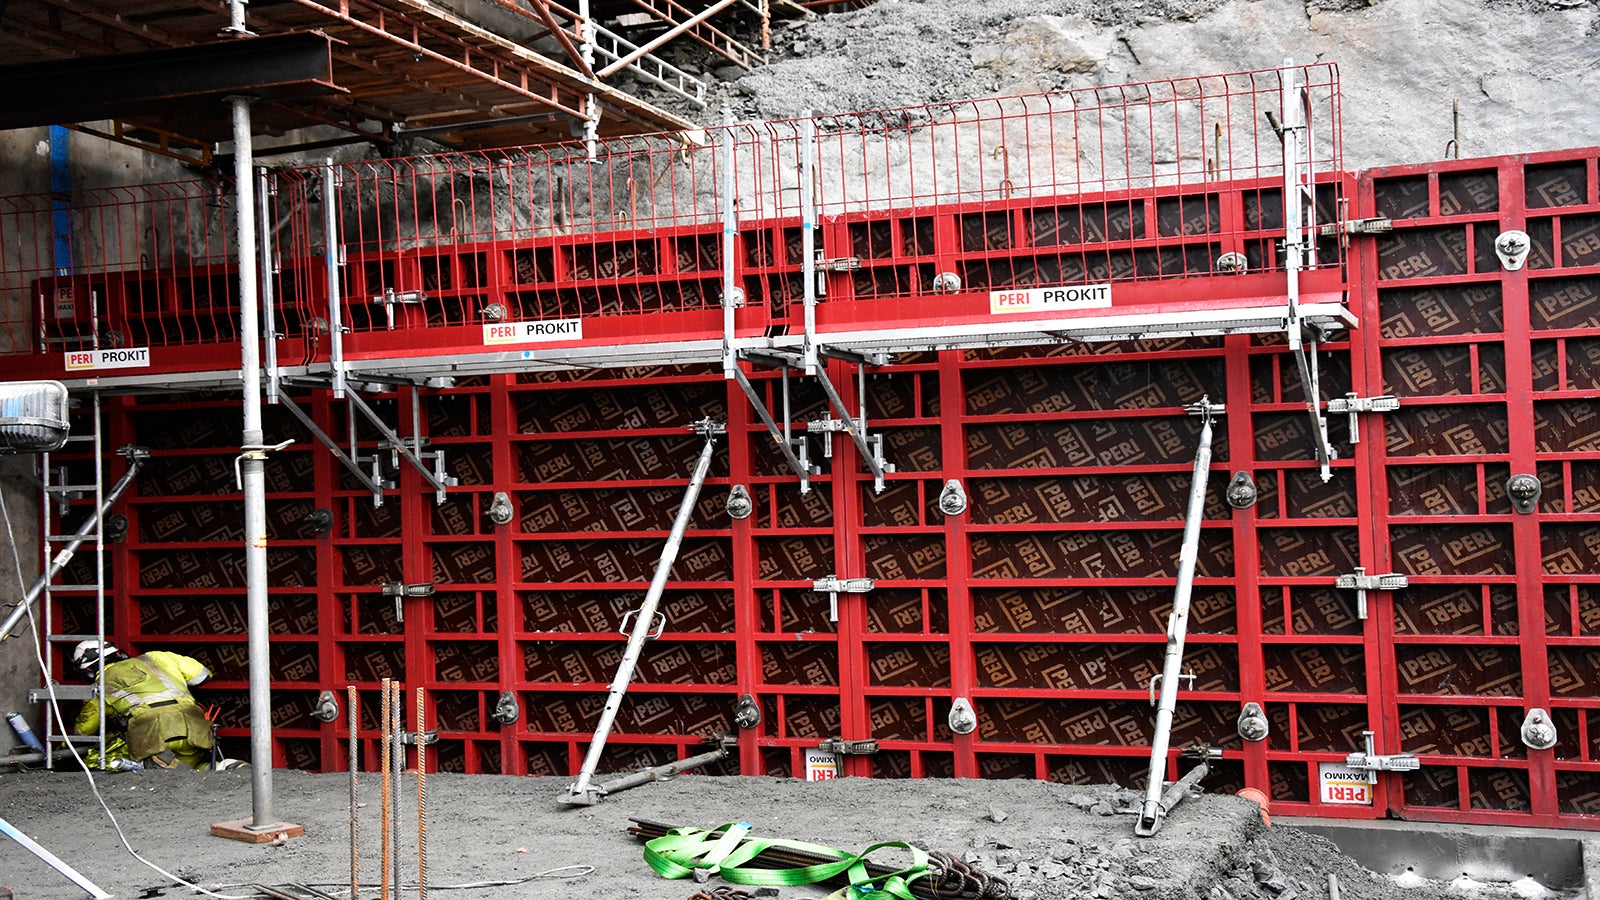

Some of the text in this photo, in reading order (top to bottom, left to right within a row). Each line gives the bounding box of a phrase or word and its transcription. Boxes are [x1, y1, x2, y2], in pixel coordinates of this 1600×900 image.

[1112, 211, 1144, 233] ERI
[1389, 251, 1431, 279] PERI
[60, 290, 72, 299] PE
[999, 287, 1107, 305] PERI PROKIT
[1543, 284, 1591, 313] PERI
[1410, 290, 1441, 328] PERI
[490, 322, 579, 337] PERI PROKIT
[1382, 321, 1408, 338] PE
[72, 350, 146, 364] PERI PROKIT
[1407, 352, 1437, 388] PERI
[968, 384, 1006, 411] PERI
[1033, 391, 1071, 413] PERI
[1055, 428, 1085, 463] PERI
[1152, 420, 1185, 455] PERI
[1256, 424, 1299, 452] PERI
[1454, 429, 1487, 454] PER
[635, 442, 662, 472] PERI
[1099, 438, 1141, 465] PERI
[540, 452, 572, 478] PERI
[705, 491, 728, 513] PER
[803, 490, 825, 517] PER
[1043, 483, 1075, 518] PERI
[1126, 480, 1152, 510] PER
[1205, 491, 1230, 520] PER
[1420, 488, 1450, 514] ERI
[157, 511, 184, 533] PERI
[522, 510, 555, 533] PERI
[890, 505, 914, 526] ERI
[993, 503, 1033, 523] PERI
[915, 542, 945, 564] PER
[1058, 532, 1098, 554] PERI
[1112, 533, 1144, 568] PERI
[1450, 529, 1496, 557] PERI
[455, 548, 488, 571] PERI
[688, 547, 722, 574] PERI
[788, 540, 816, 573] PERI
[1015, 539, 1045, 573] PERI
[1288, 550, 1330, 576] PERI
[1410, 551, 1442, 574] PER
[1546, 557, 1576, 574] PE
[881, 559, 904, 579] PE
[671, 592, 704, 617] PERI
[1008, 595, 1037, 629] PERI
[1195, 590, 1235, 615] PERI
[1425, 598, 1472, 626] PERI
[894, 606, 921, 629] ERI
[1061, 612, 1087, 633] ERI
[598, 646, 624, 669] ERI
[652, 650, 688, 675] PERI
[763, 654, 781, 678] ERI
[876, 649, 914, 673] PERI
[977, 648, 1008, 683] PERI
[1019, 646, 1057, 665] PERI
[1181, 653, 1216, 675] PER
[1300, 648, 1336, 685] PERI
[1407, 648, 1452, 676] PERI
[284, 662, 314, 681] PERI
[709, 663, 736, 684] PER
[803, 661, 827, 685] ERI
[1051, 668, 1078, 689] PE
[1131, 664, 1153, 689] ERI
[1266, 665, 1288, 687] ERI
[273, 701, 300, 723] PERI
[636, 696, 669, 719] PERI
[872, 711, 892, 731] PE
[1065, 715, 1105, 741] PERI
[1120, 719, 1148, 746] PER
[1401, 721, 1429, 741] PE
[530, 753, 552, 775] ERI
[1324, 771, 1369, 781] MAXIMO
[1329, 787, 1365, 800] PERI
